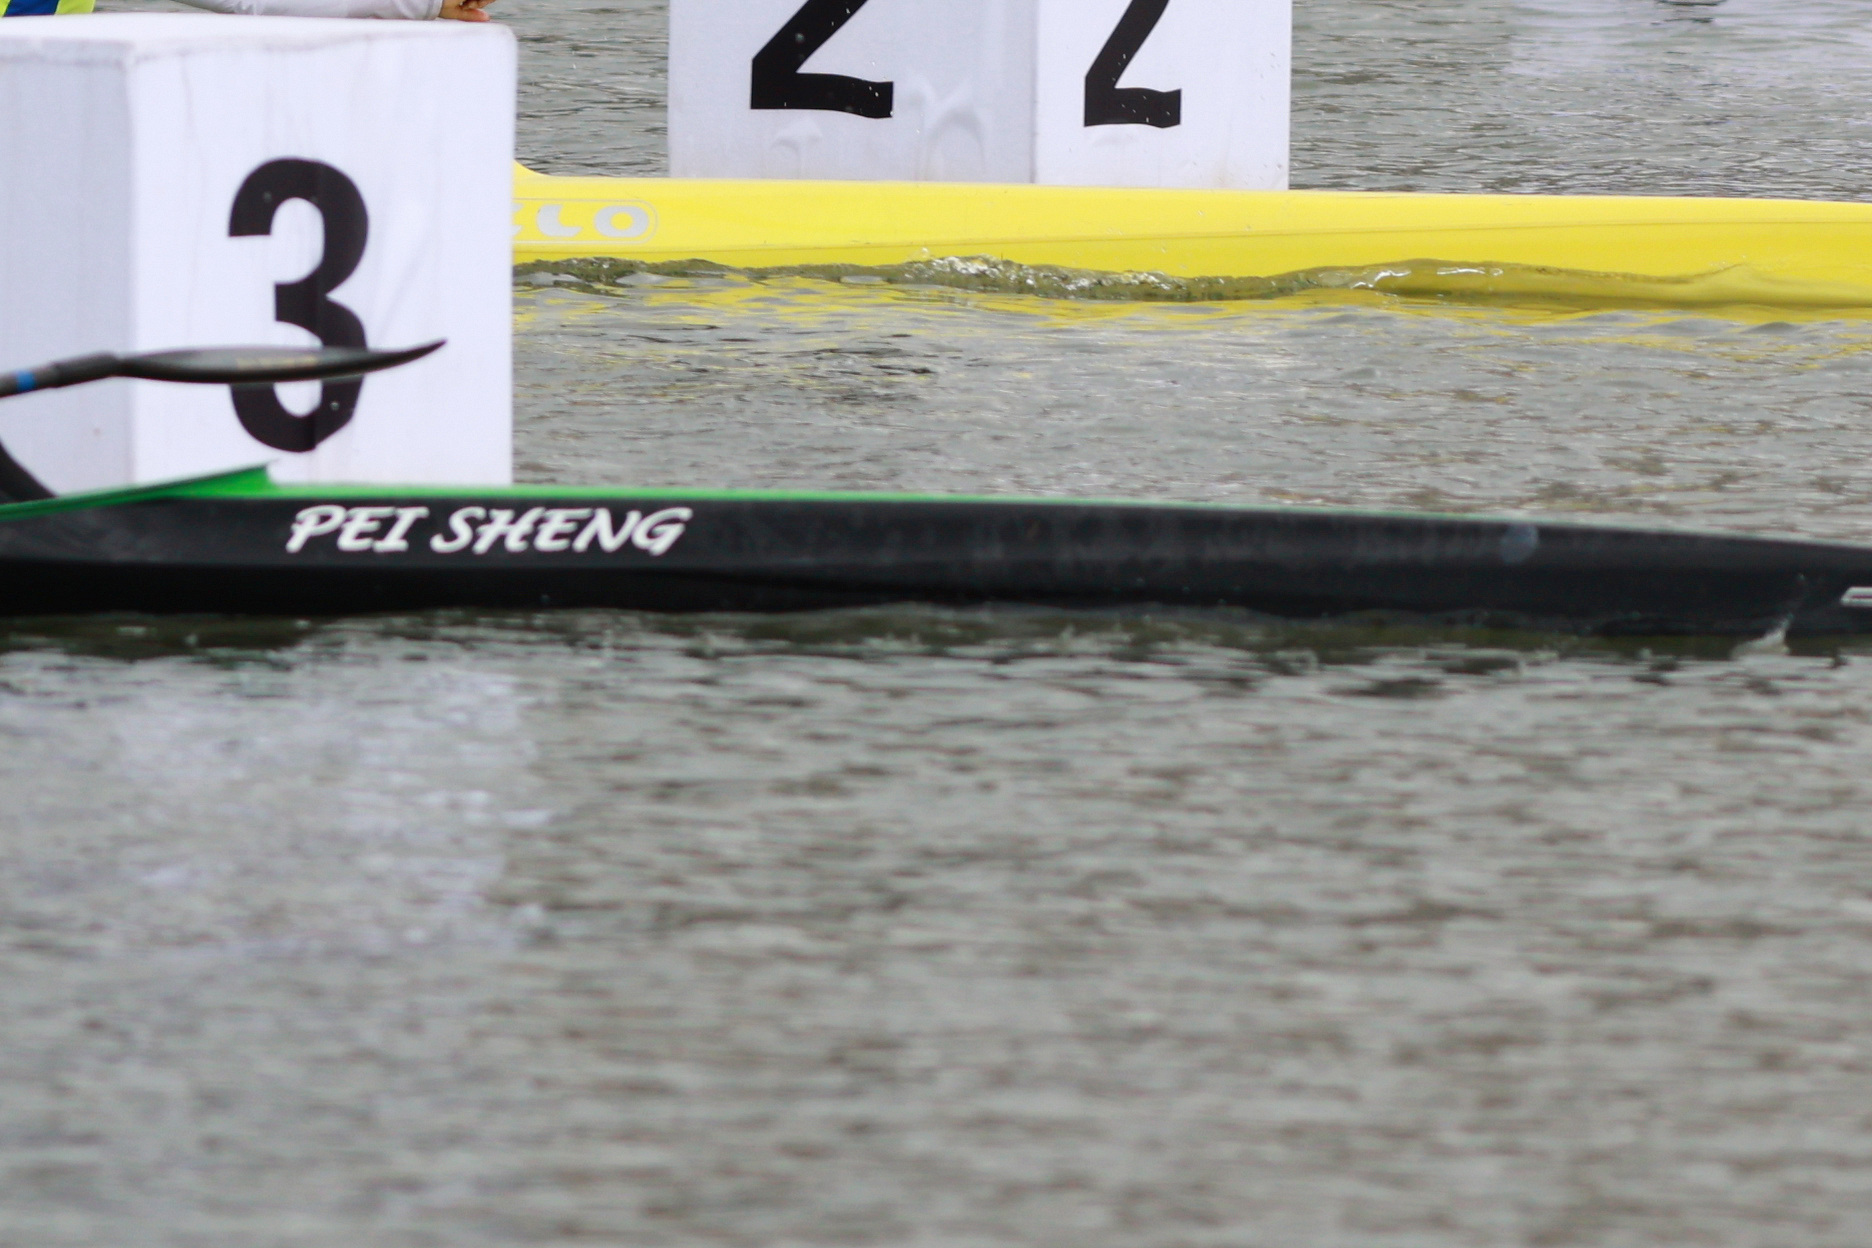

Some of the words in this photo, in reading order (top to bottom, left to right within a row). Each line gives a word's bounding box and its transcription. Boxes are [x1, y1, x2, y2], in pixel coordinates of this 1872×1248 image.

[513, 203, 649, 238] LO
[228, 156, 368, 452] 3
[285, 504, 429, 553] PEI
[430, 506, 693, 556] SHENG
